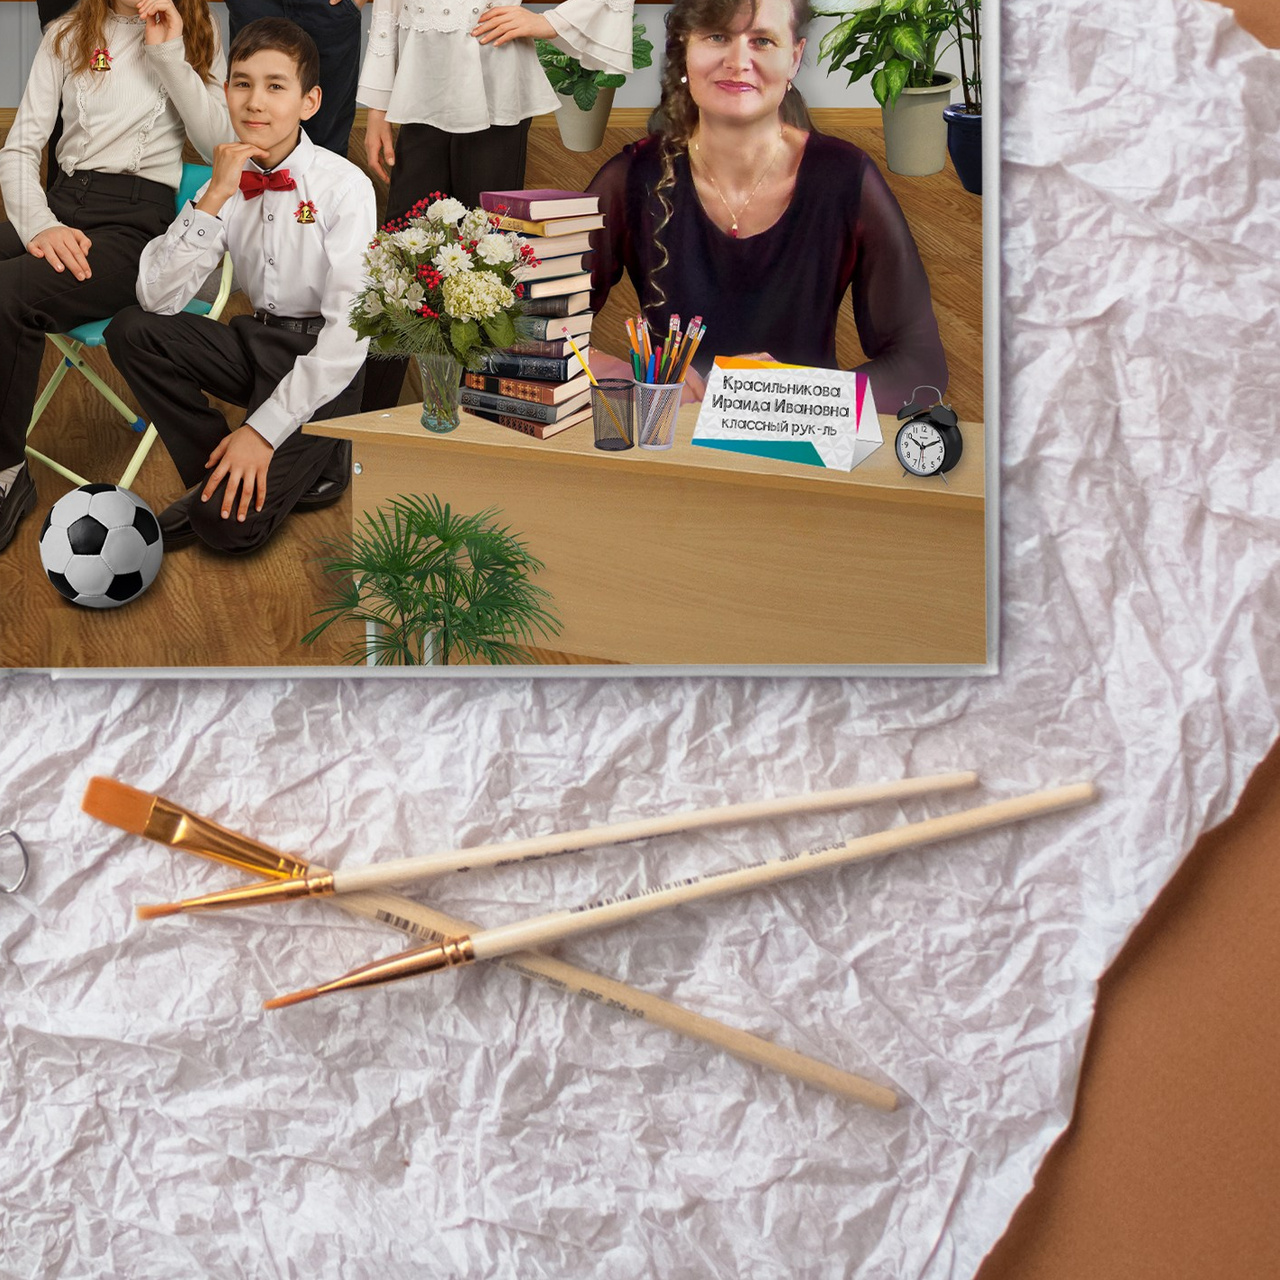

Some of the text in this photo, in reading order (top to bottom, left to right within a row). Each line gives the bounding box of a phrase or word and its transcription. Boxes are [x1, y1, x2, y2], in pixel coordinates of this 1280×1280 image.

[96, 58, 106, 67] 11
[300, 210, 312, 220] 12
[722, 375, 842, 398] Красильникова
[711, 394, 850, 418] Ираида Ивановна
[721, 418, 789, 433] классный
